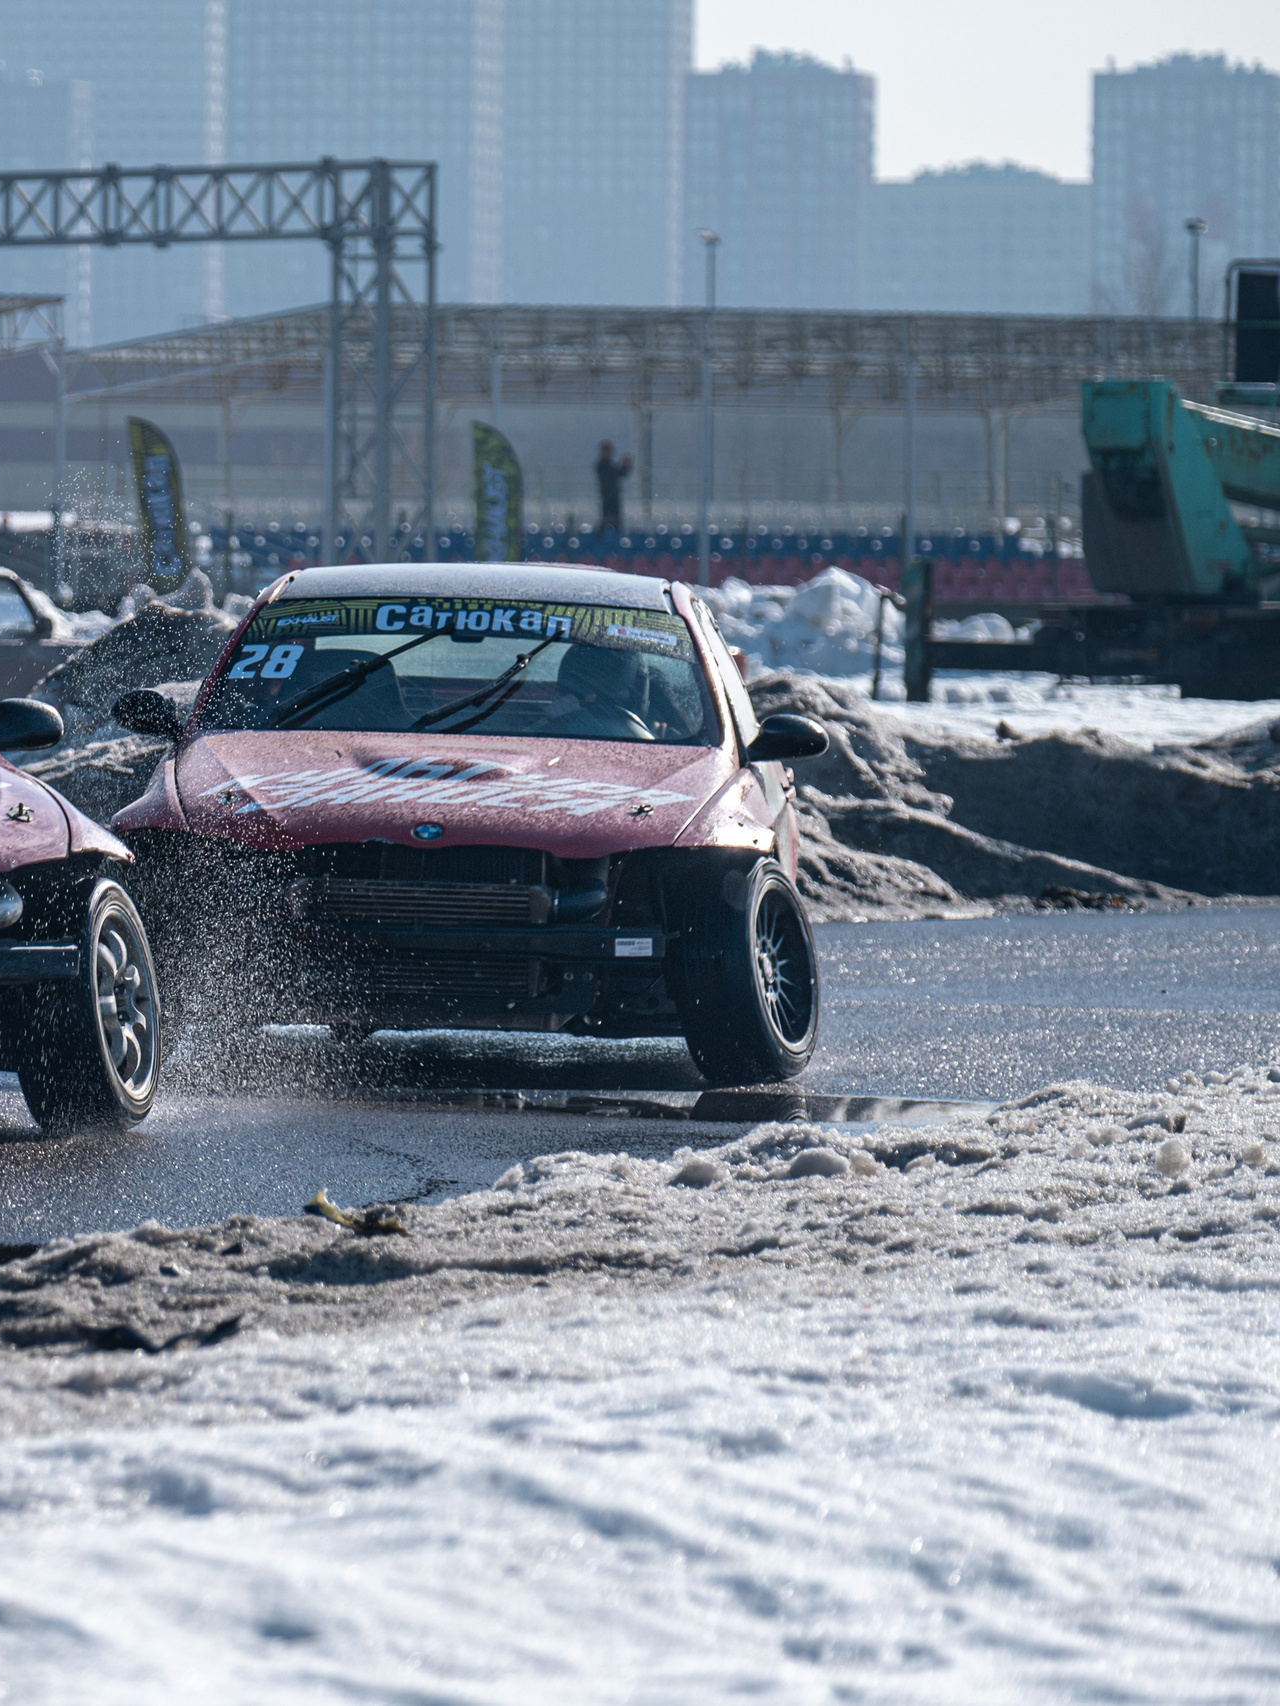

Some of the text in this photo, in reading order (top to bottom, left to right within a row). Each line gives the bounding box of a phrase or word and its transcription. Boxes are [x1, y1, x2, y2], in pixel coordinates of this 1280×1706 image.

[277, 613, 340, 627] EXHAUST
[375, 604, 571, 638] Сатюкап
[228, 644, 304, 679] 28
